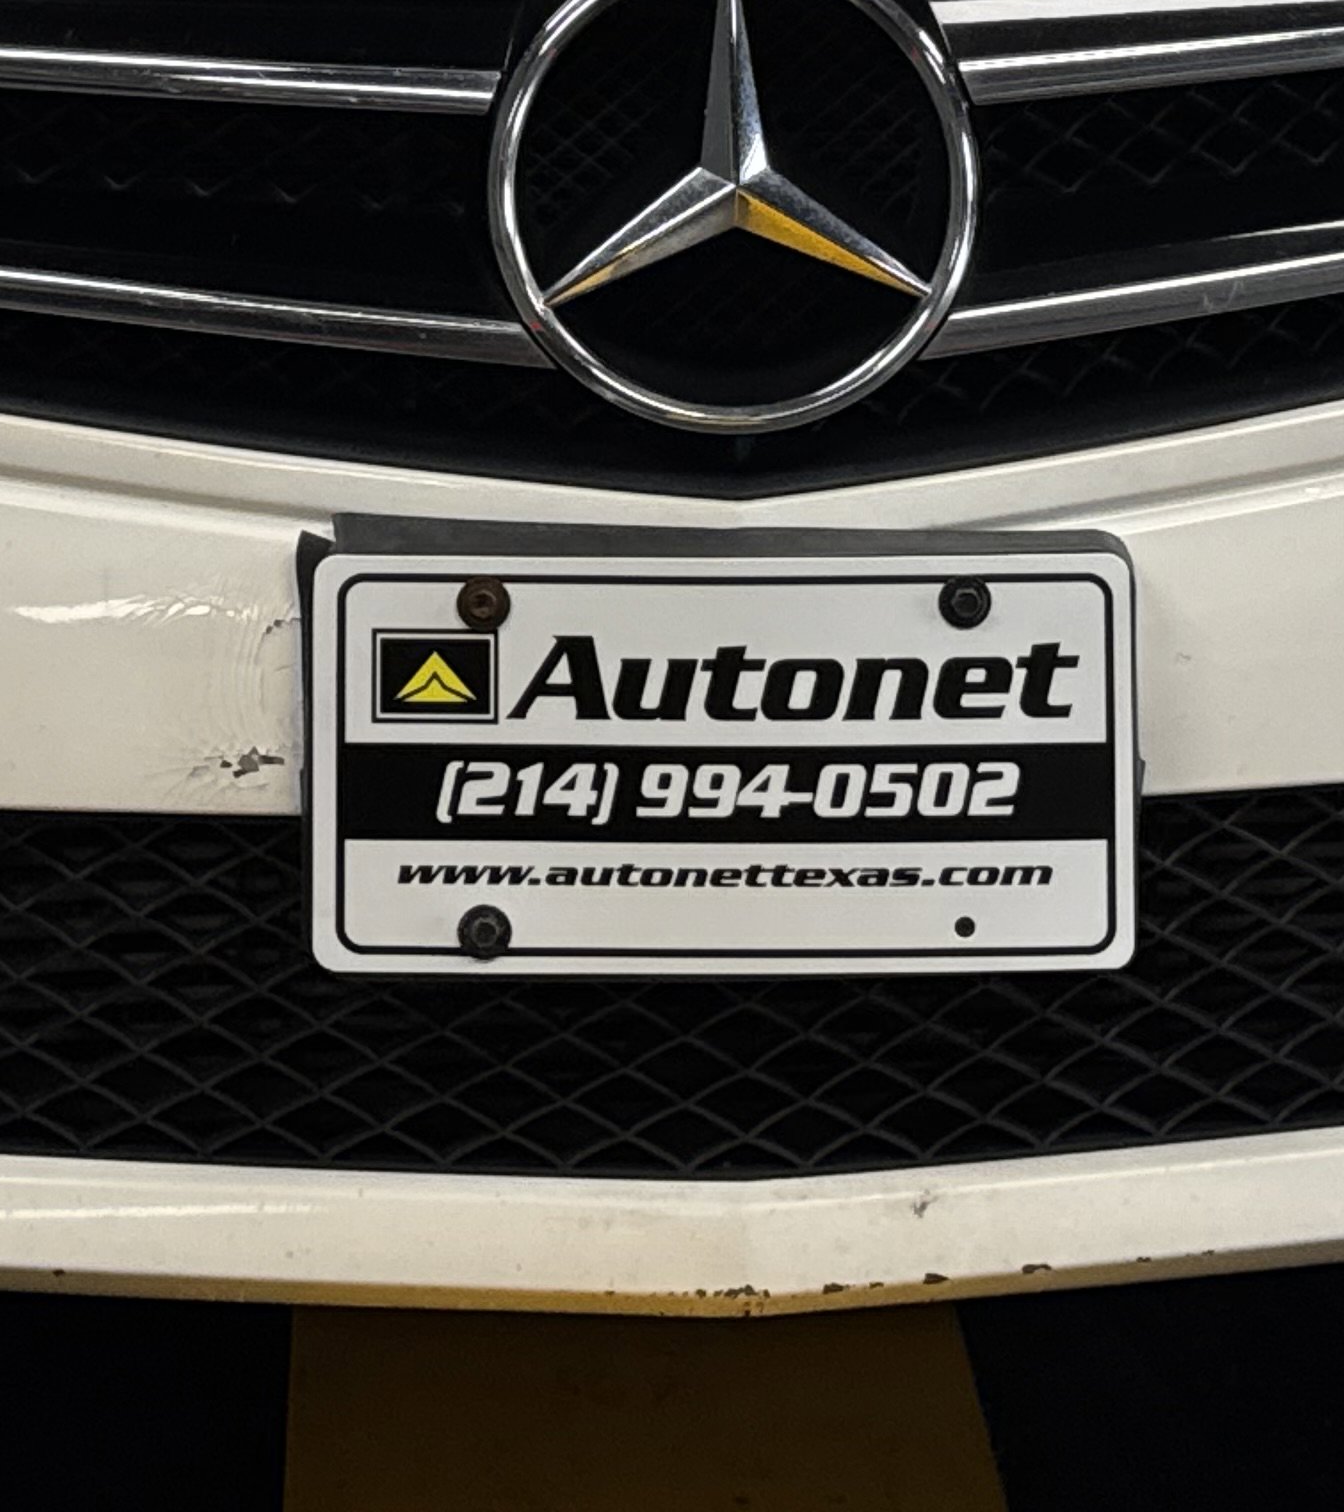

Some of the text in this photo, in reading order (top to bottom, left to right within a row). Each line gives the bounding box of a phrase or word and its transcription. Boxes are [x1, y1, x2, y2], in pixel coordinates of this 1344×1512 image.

[507, 635, 1080, 721] Autonet
[437, 761, 1020, 825] (214) 994-0502
[397, 860, 1053, 888] www.autonettexas.com
